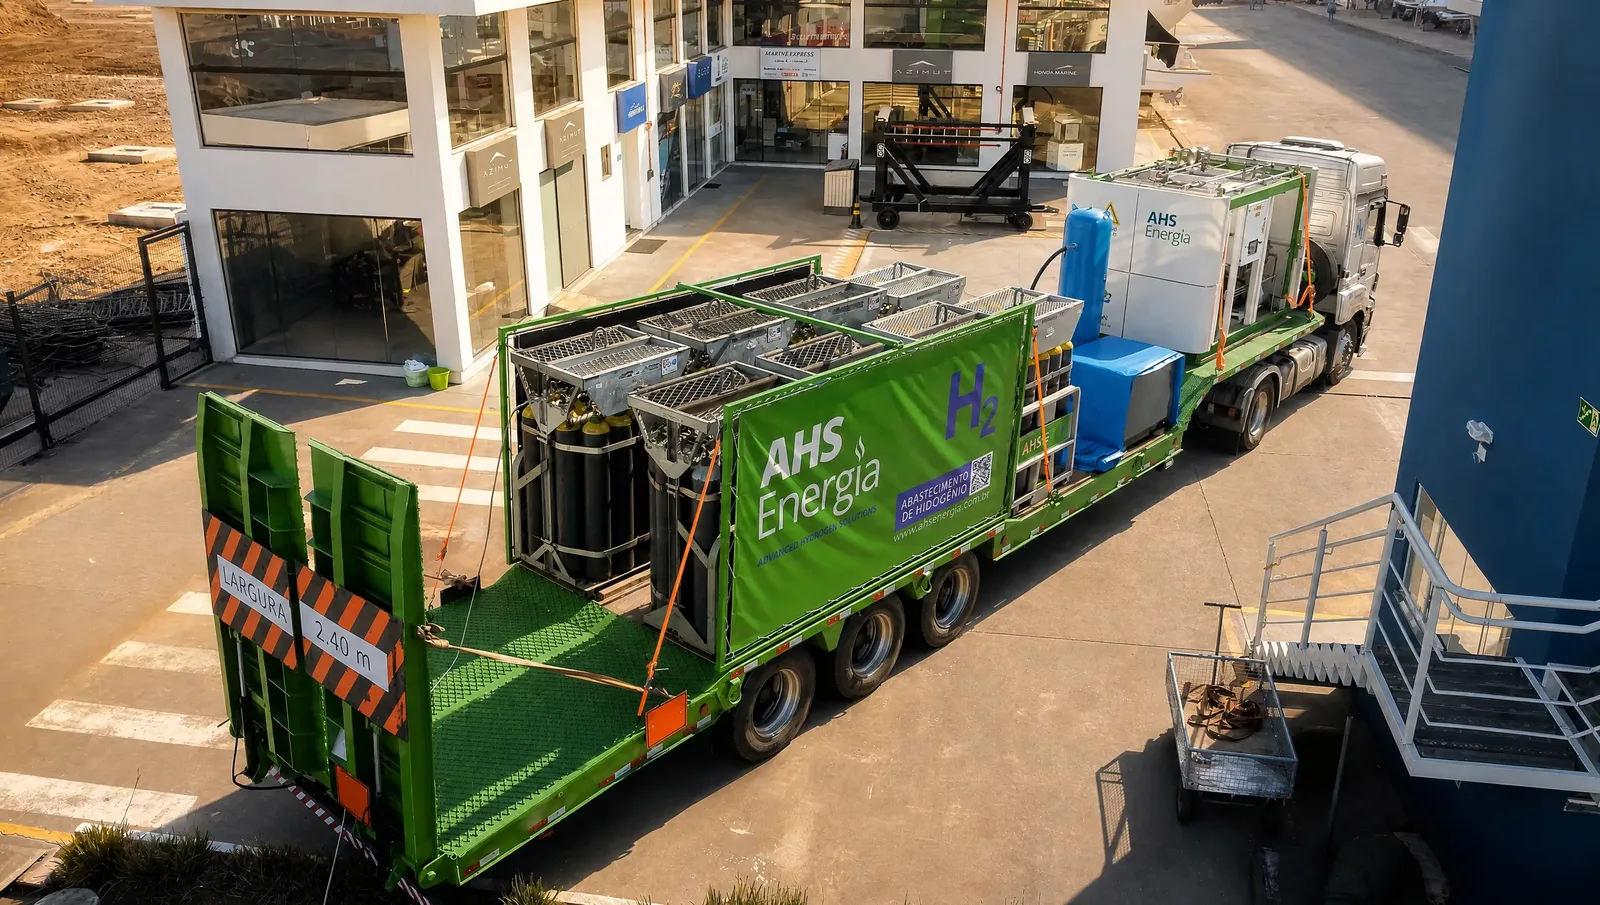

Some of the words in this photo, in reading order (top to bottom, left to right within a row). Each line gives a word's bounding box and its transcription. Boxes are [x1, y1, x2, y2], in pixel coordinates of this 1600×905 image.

[1145, 225, 1191, 246] Energia
[1147, 211, 1177, 227] AHS
[760, 416, 845, 489] AHS
[1022, 435, 1042, 456] AHS
[758, 436, 881, 540] Energia
[900, 471, 969, 511] ABASTECIMENTO
[901, 508, 914, 523] DE
[915, 483, 968, 516] HIDOGÊNIO
[757, 541, 799, 568] ADVANCED
[800, 523, 838, 546] HYDROGEN
[839, 505, 878, 528] SOLUTIONS
[893, 491, 990, 542] www.ahsenergia.com.br
[222, 565, 288, 625] LARGURA
[315, 620, 350, 658] 2.40
[355, 649, 372, 672] m
